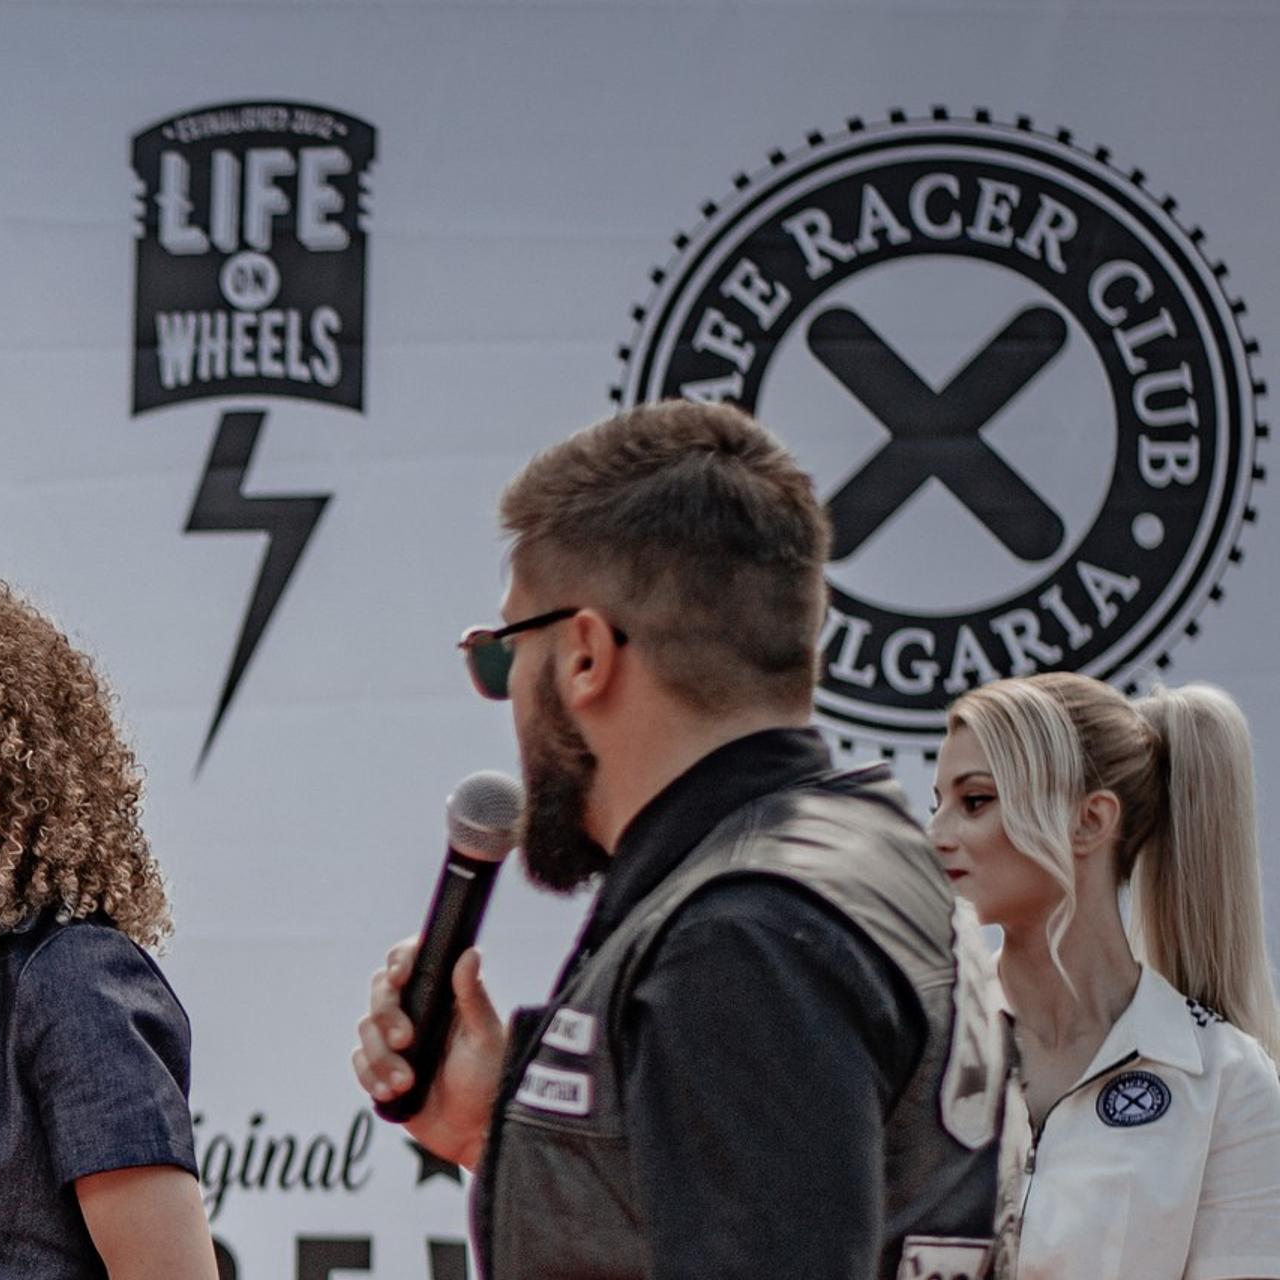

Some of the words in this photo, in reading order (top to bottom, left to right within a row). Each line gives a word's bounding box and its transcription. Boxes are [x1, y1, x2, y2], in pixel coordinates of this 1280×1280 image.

[153, 145, 353, 256] LIFE
[154, 305, 343, 391] WHEELS
[781, 172, 1080, 282] RACER
[1087, 257, 1202, 490] CLUB
